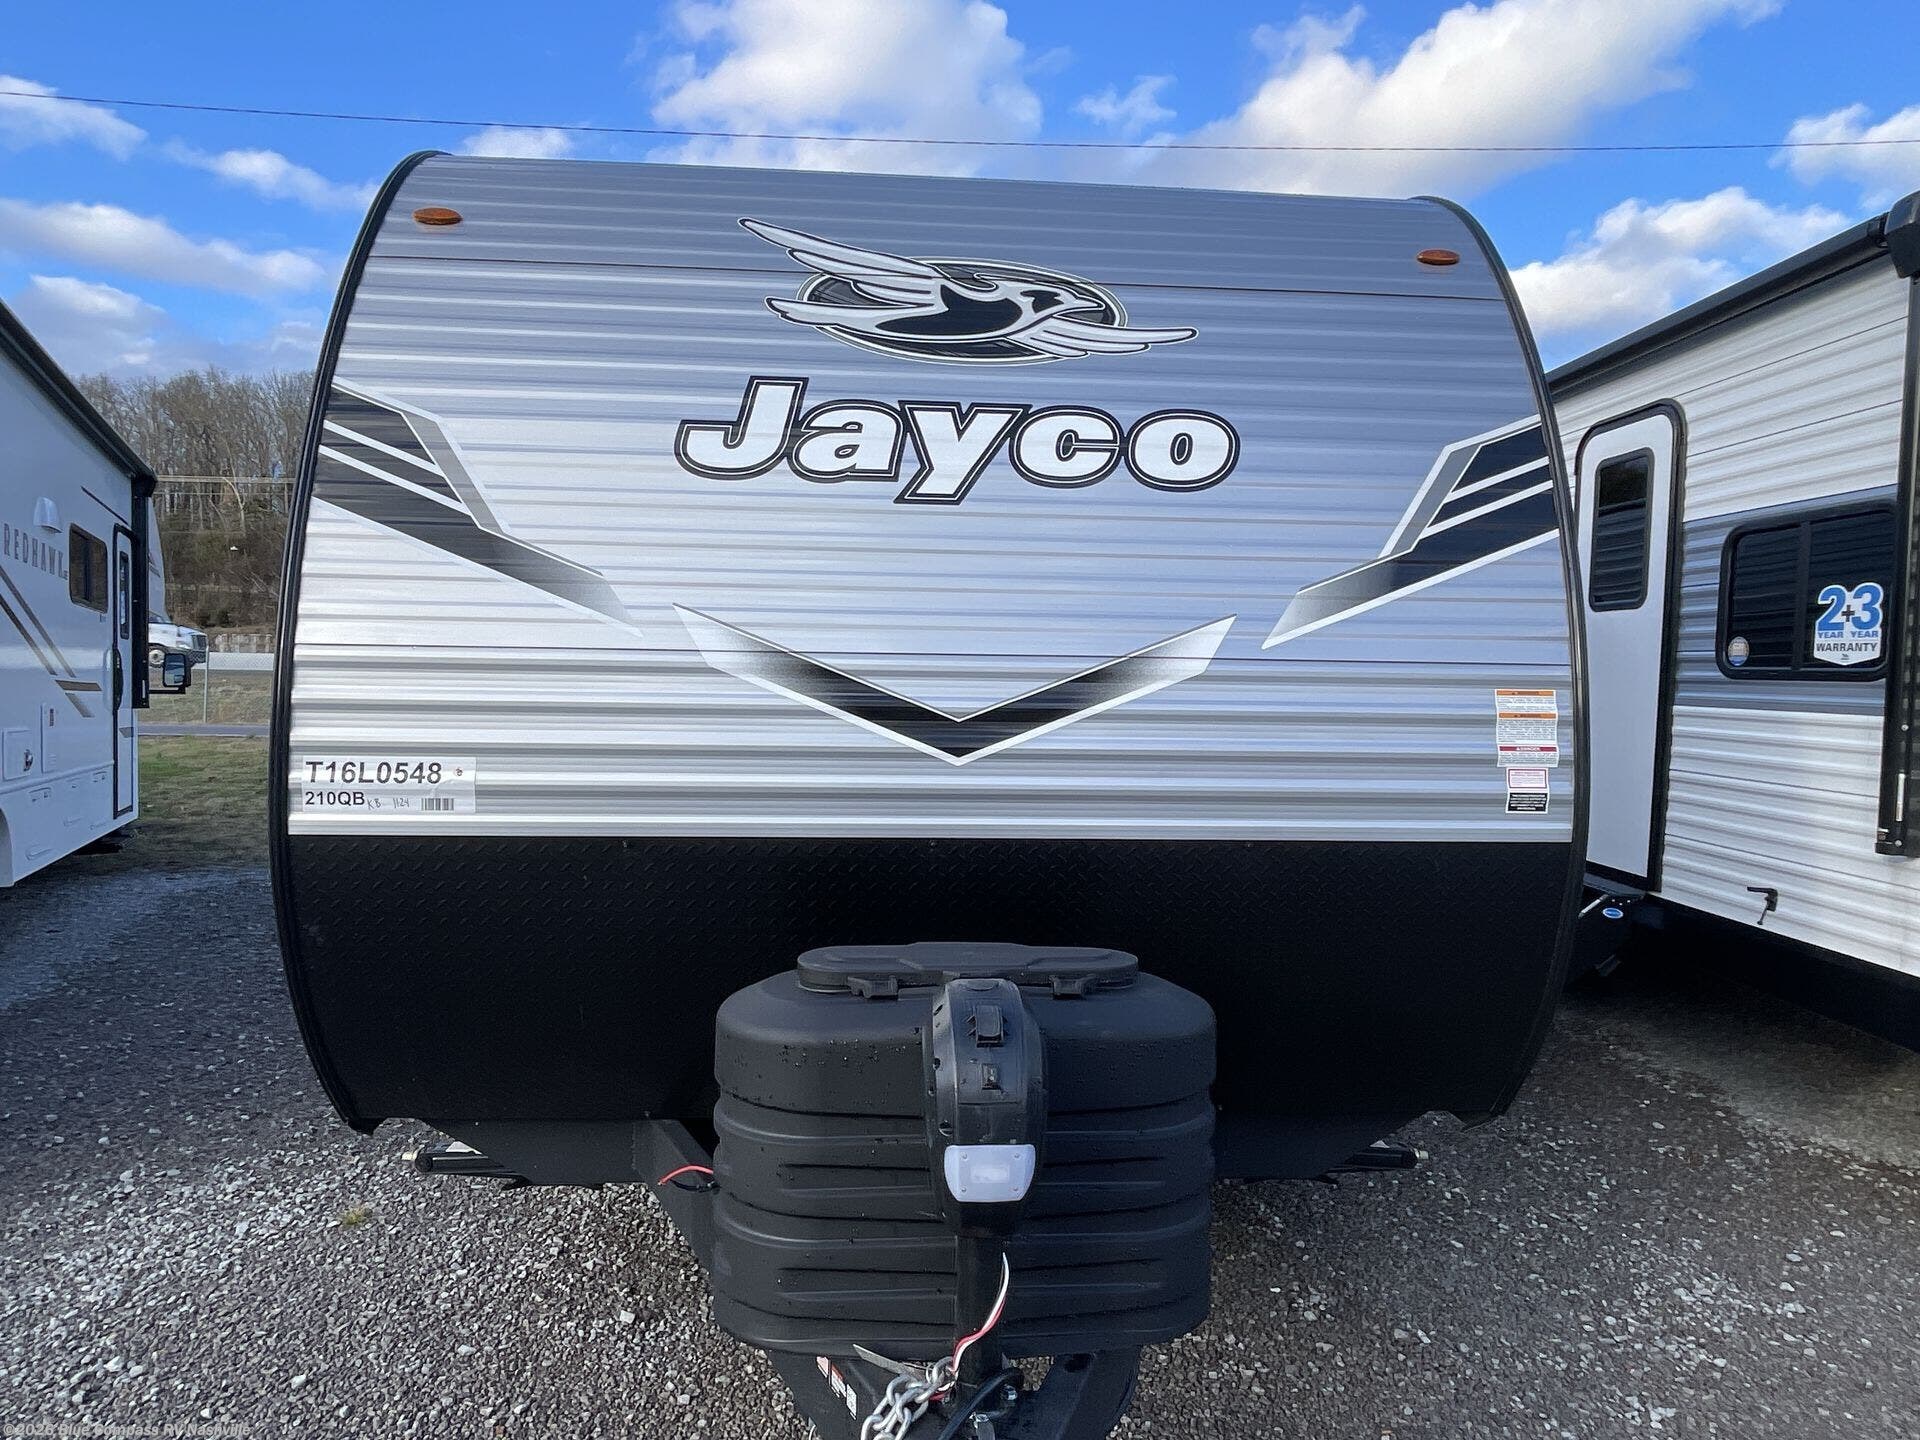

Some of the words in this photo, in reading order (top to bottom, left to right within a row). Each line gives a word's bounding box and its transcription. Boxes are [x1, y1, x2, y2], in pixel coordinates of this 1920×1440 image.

[674, 375, 1241, 505] Jayco
[3, 522, 64, 579] REDHAWK
[1817, 630, 1844, 639] YEAR
[1850, 630, 1879, 639] YEAR
[1816, 641, 1878, 653] WARRANTY
[305, 761, 442, 784] T16L0548
[305, 791, 365, 806] 210QB
